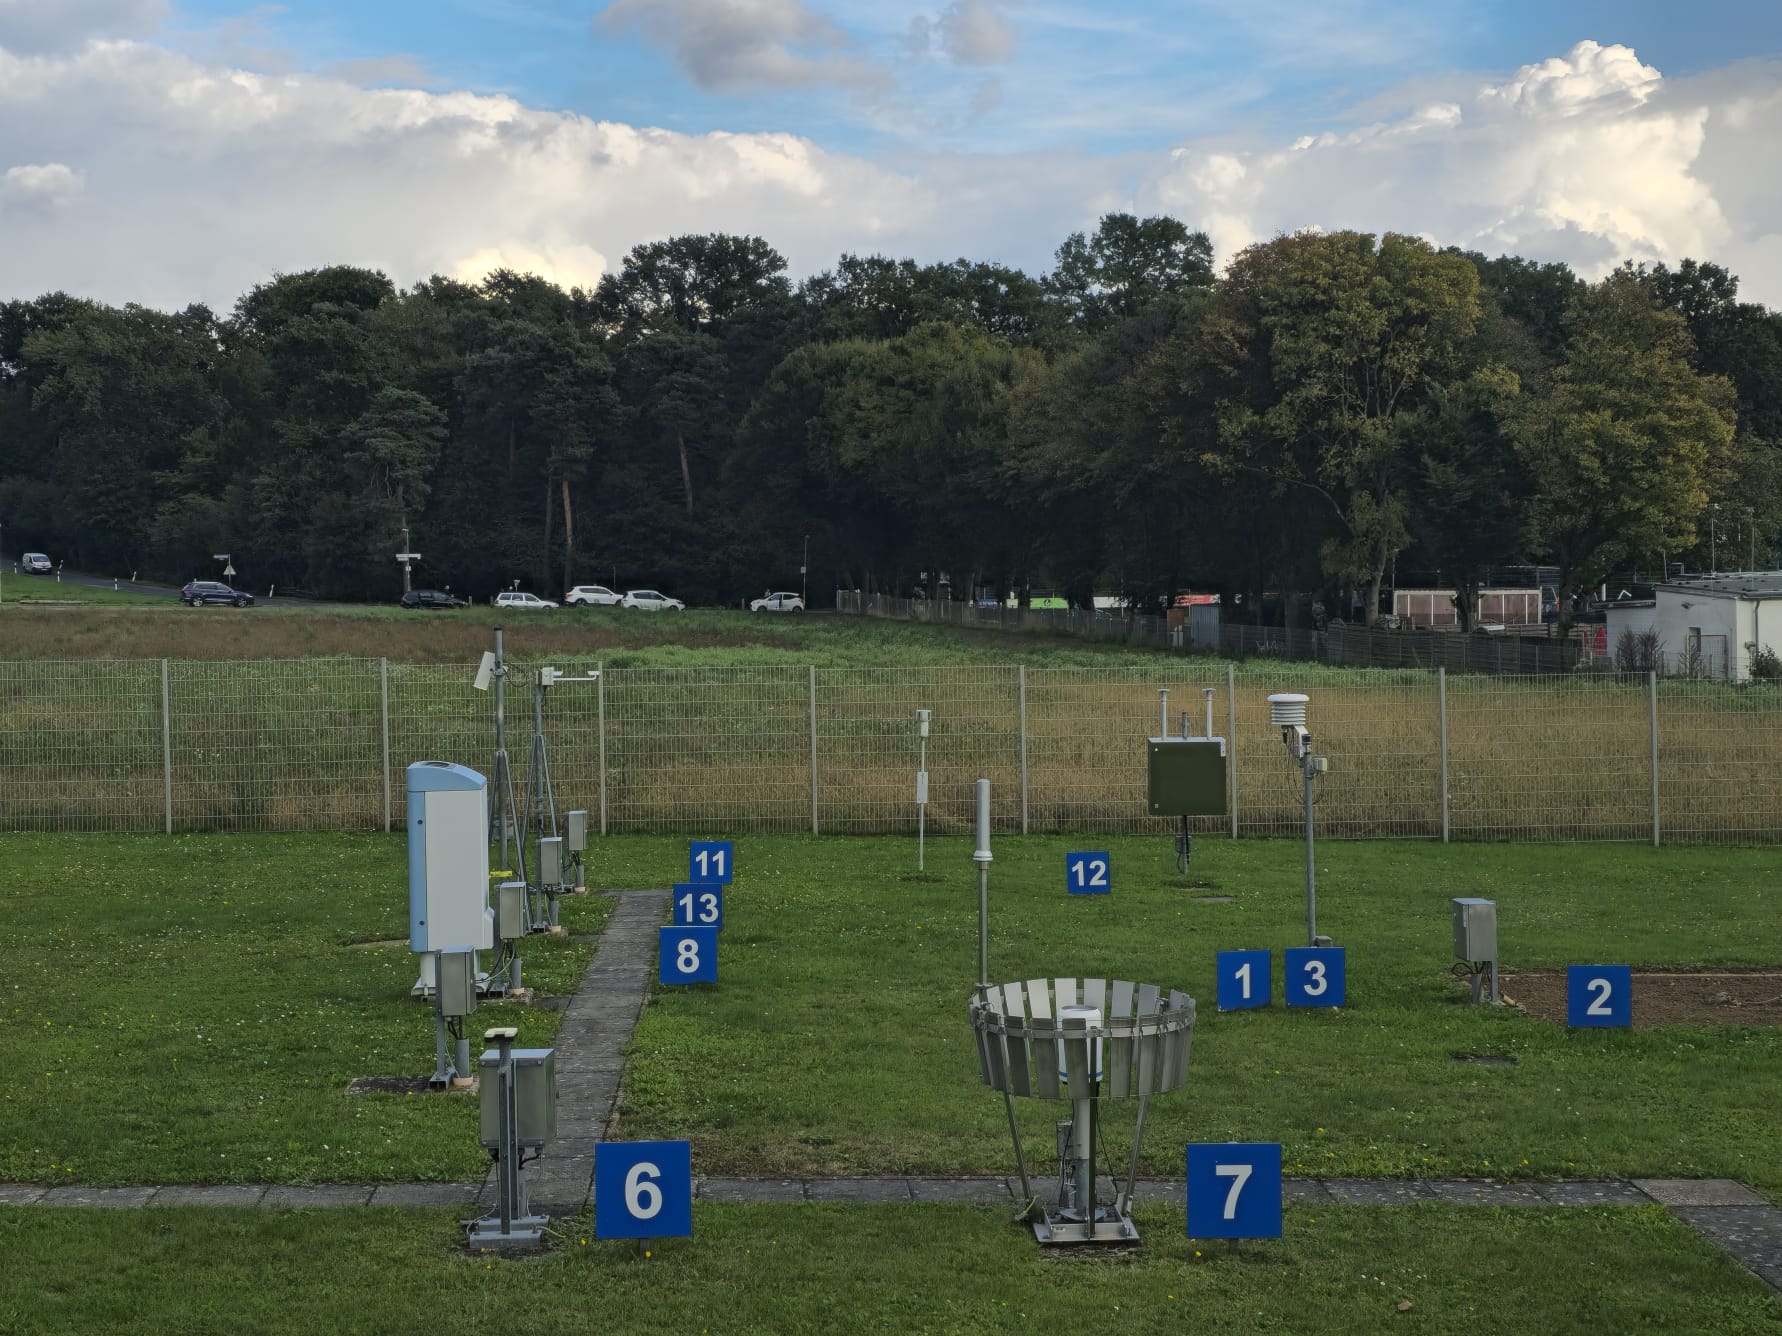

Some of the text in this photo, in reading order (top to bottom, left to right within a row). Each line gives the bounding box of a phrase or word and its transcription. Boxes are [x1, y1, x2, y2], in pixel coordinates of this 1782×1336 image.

[694, 850, 725, 877] 11
[1071, 860, 1108, 887] 12
[678, 893, 720, 924] 13
[677, 939, 701, 974] 8
[1235, 963, 1251, 999] 1
[1304, 960, 1328, 996] 3
[1587, 978, 1613, 1016] 2
[625, 1162, 663, 1220] 6
[1215, 1164, 1253, 1220] 7
